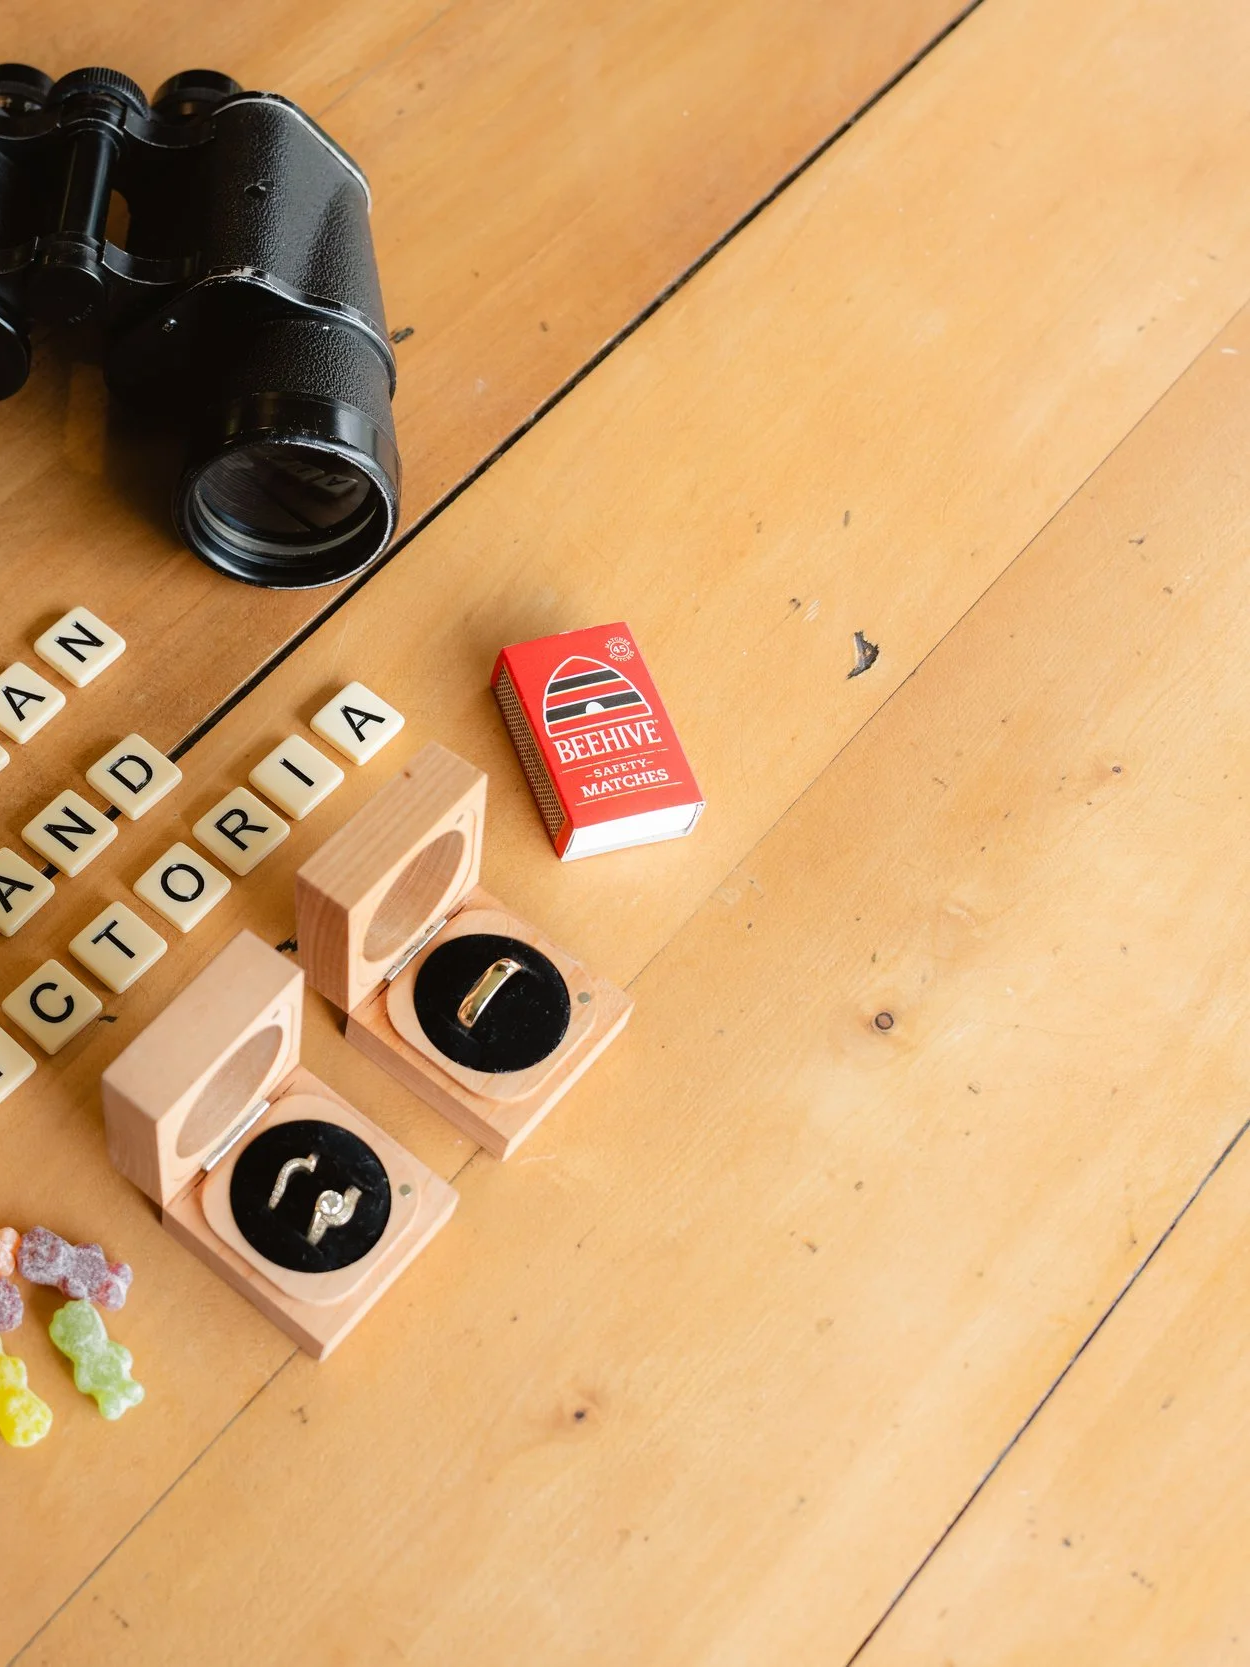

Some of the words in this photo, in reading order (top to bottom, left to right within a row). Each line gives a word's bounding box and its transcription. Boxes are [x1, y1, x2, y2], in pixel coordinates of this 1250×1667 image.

[605, 637, 630, 648] MATCHES
[613, 645, 627, 654] 45
[553, 720, 662, 764] BEEHIVE
[593, 759, 647, 778] SAFETY
[580, 768, 669, 798] MATCHES
